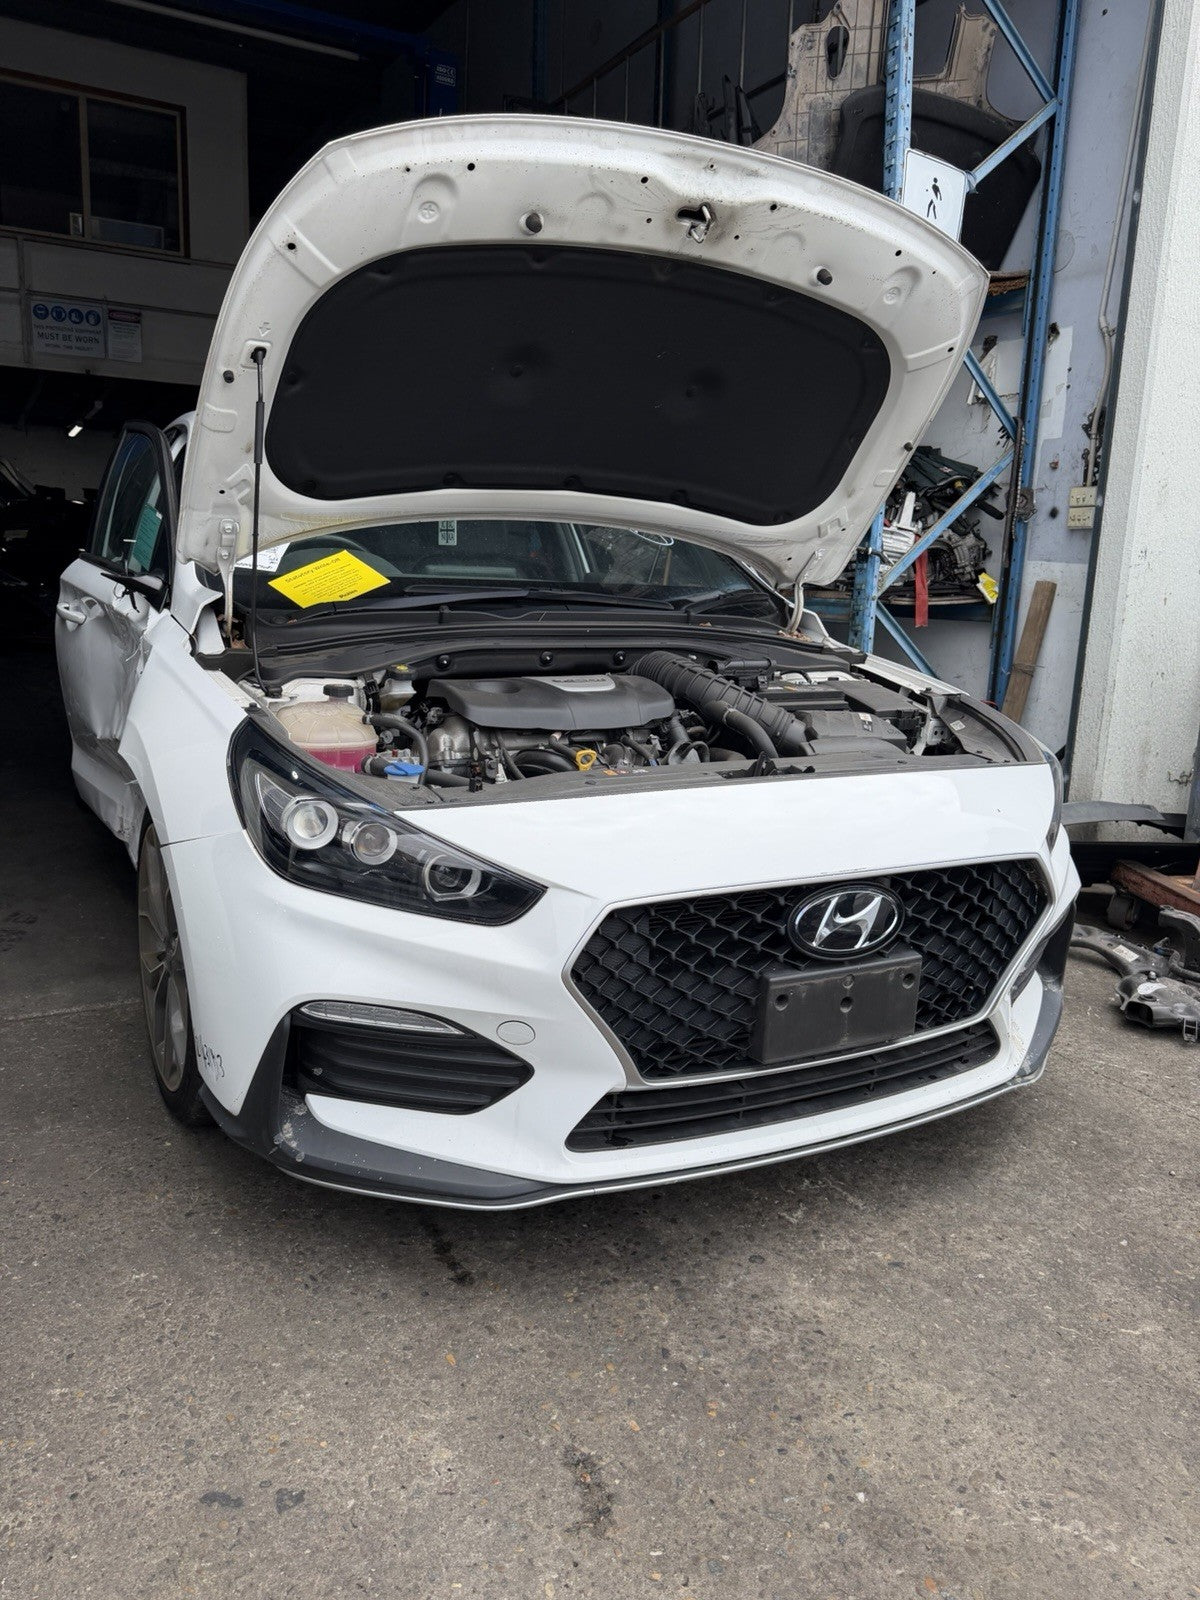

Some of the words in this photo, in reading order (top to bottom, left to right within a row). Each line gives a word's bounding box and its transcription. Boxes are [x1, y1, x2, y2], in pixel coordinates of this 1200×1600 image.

[37, 331, 59, 340] MUST
[62, 334, 72, 342] BE
[75, 335, 100, 344] WORN
